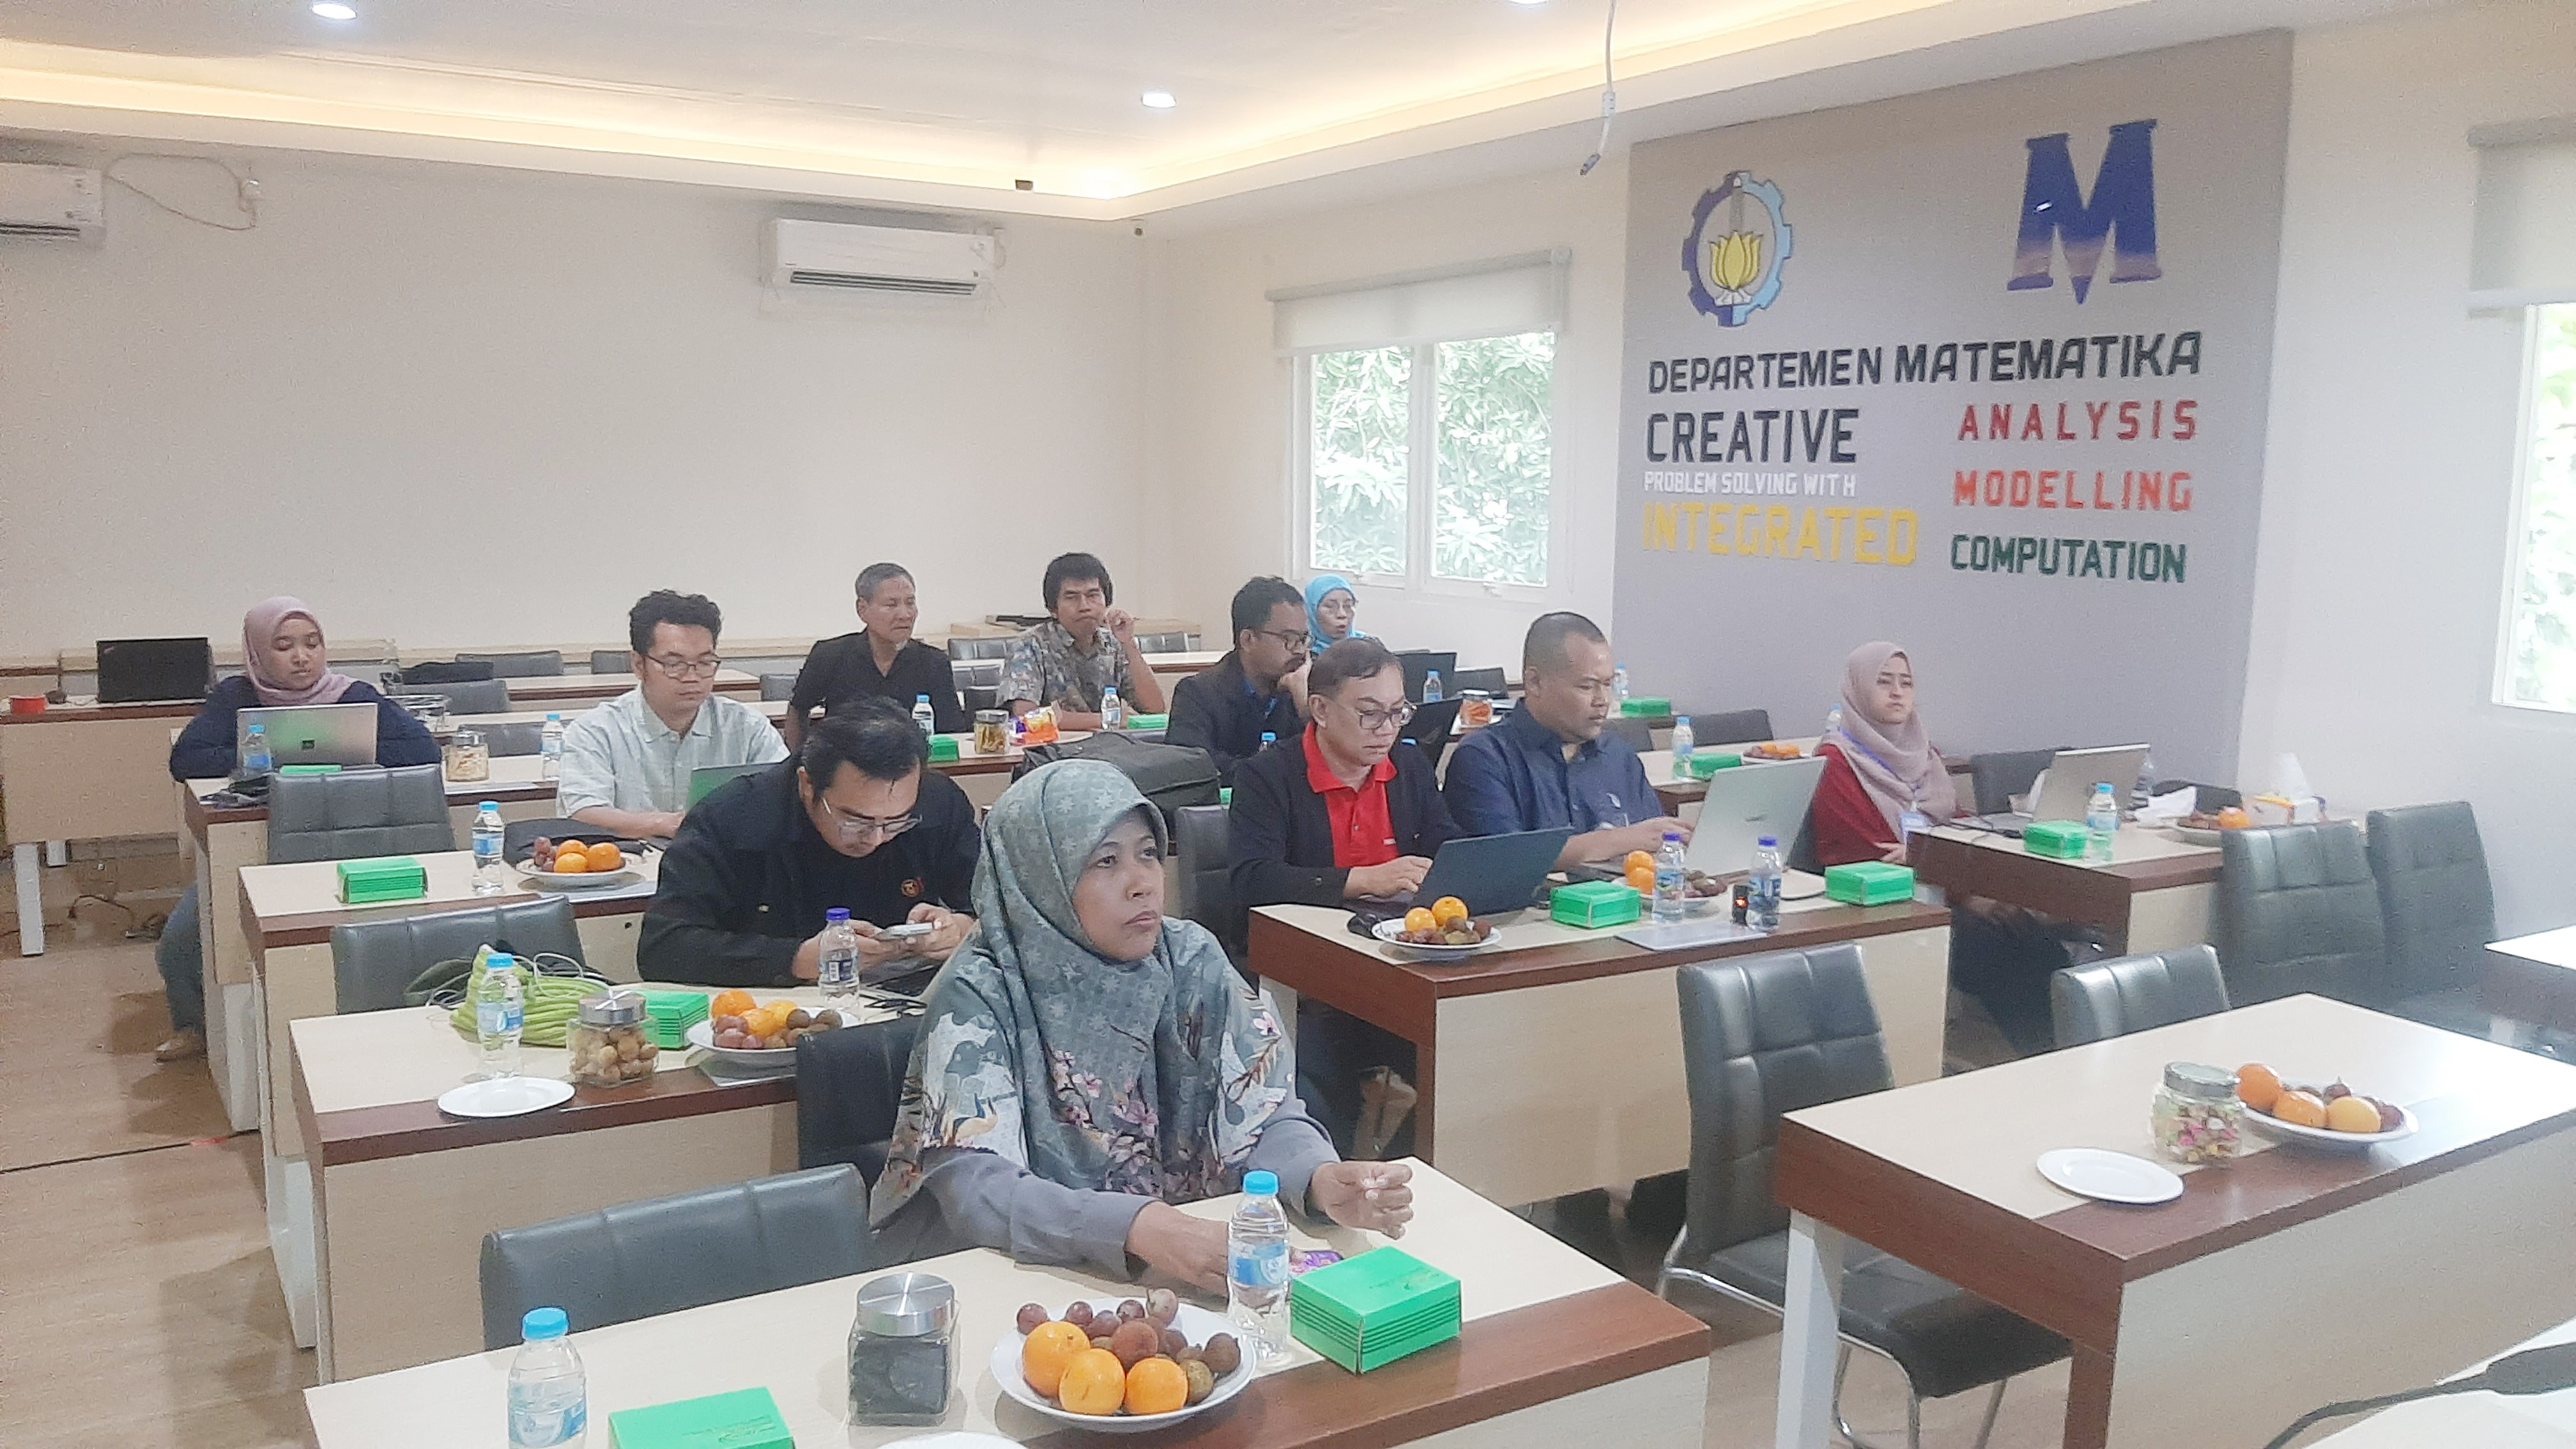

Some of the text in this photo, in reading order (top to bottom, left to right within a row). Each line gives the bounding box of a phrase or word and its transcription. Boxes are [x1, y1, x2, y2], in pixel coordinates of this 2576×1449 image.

[2007, 118, 2161, 305] M
[1648, 331, 2202, 394] DEPARTEMEN MATEMATIKA
[1646, 408, 1859, 463] CREATIVE
[1958, 399, 2198, 441] ANALYSIS
[1644, 471, 1857, 496] PROBLEM SOLVING WITH
[1953, 470, 2193, 510] MODELLING
[1643, 503, 1919, 565] INTEGRATED
[1951, 534, 2186, 583] COMPUTATION
